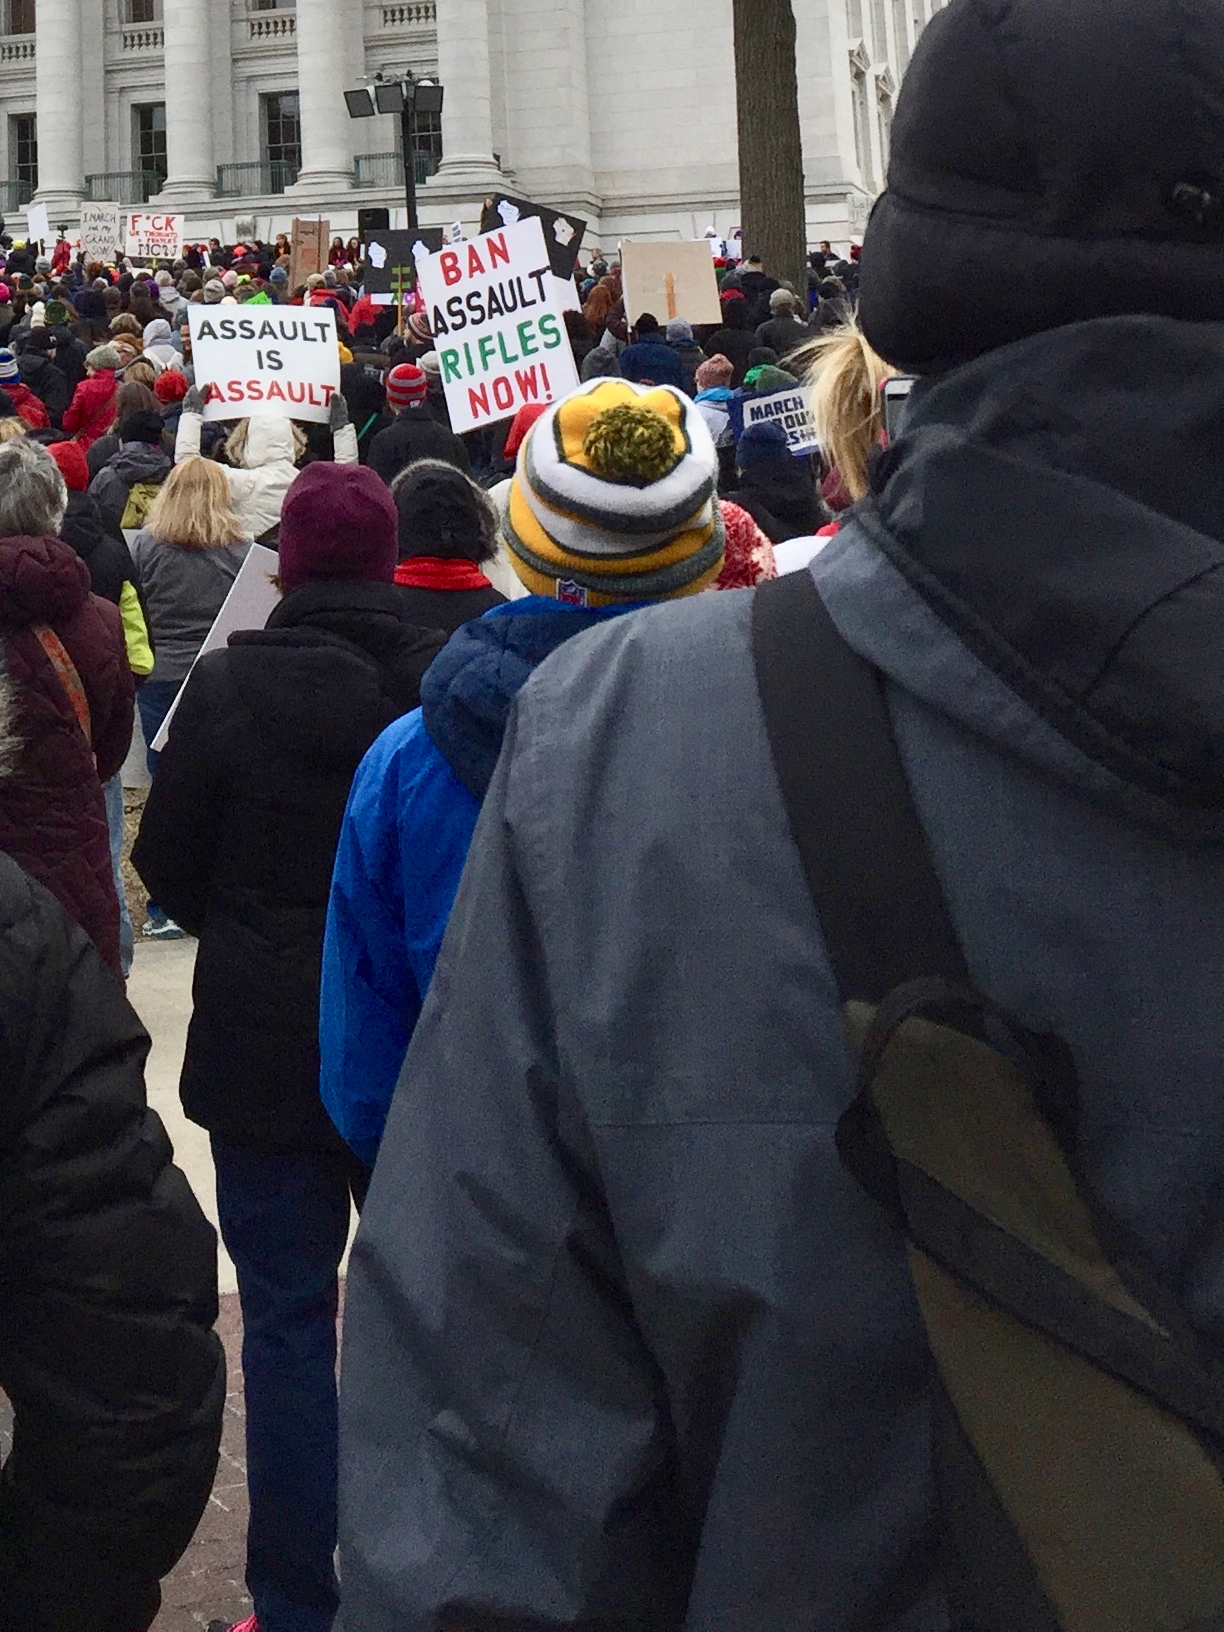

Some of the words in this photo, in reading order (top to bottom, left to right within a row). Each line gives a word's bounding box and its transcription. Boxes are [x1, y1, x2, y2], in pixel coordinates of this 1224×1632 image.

[89, 212, 116, 223] MARCH
[85, 233, 115, 244] GRAND
[439, 232, 510, 286] BAN
[433, 265, 552, 338] ASSAULT
[197, 319, 331, 343] ASSAULT
[256, 349, 284, 371] IS
[440, 313, 561, 384] RIFLES
[204, 379, 336, 408] ASSAULT
[468, 362, 553, 419] NOW!
[750, 395, 805, 421] MARCH
